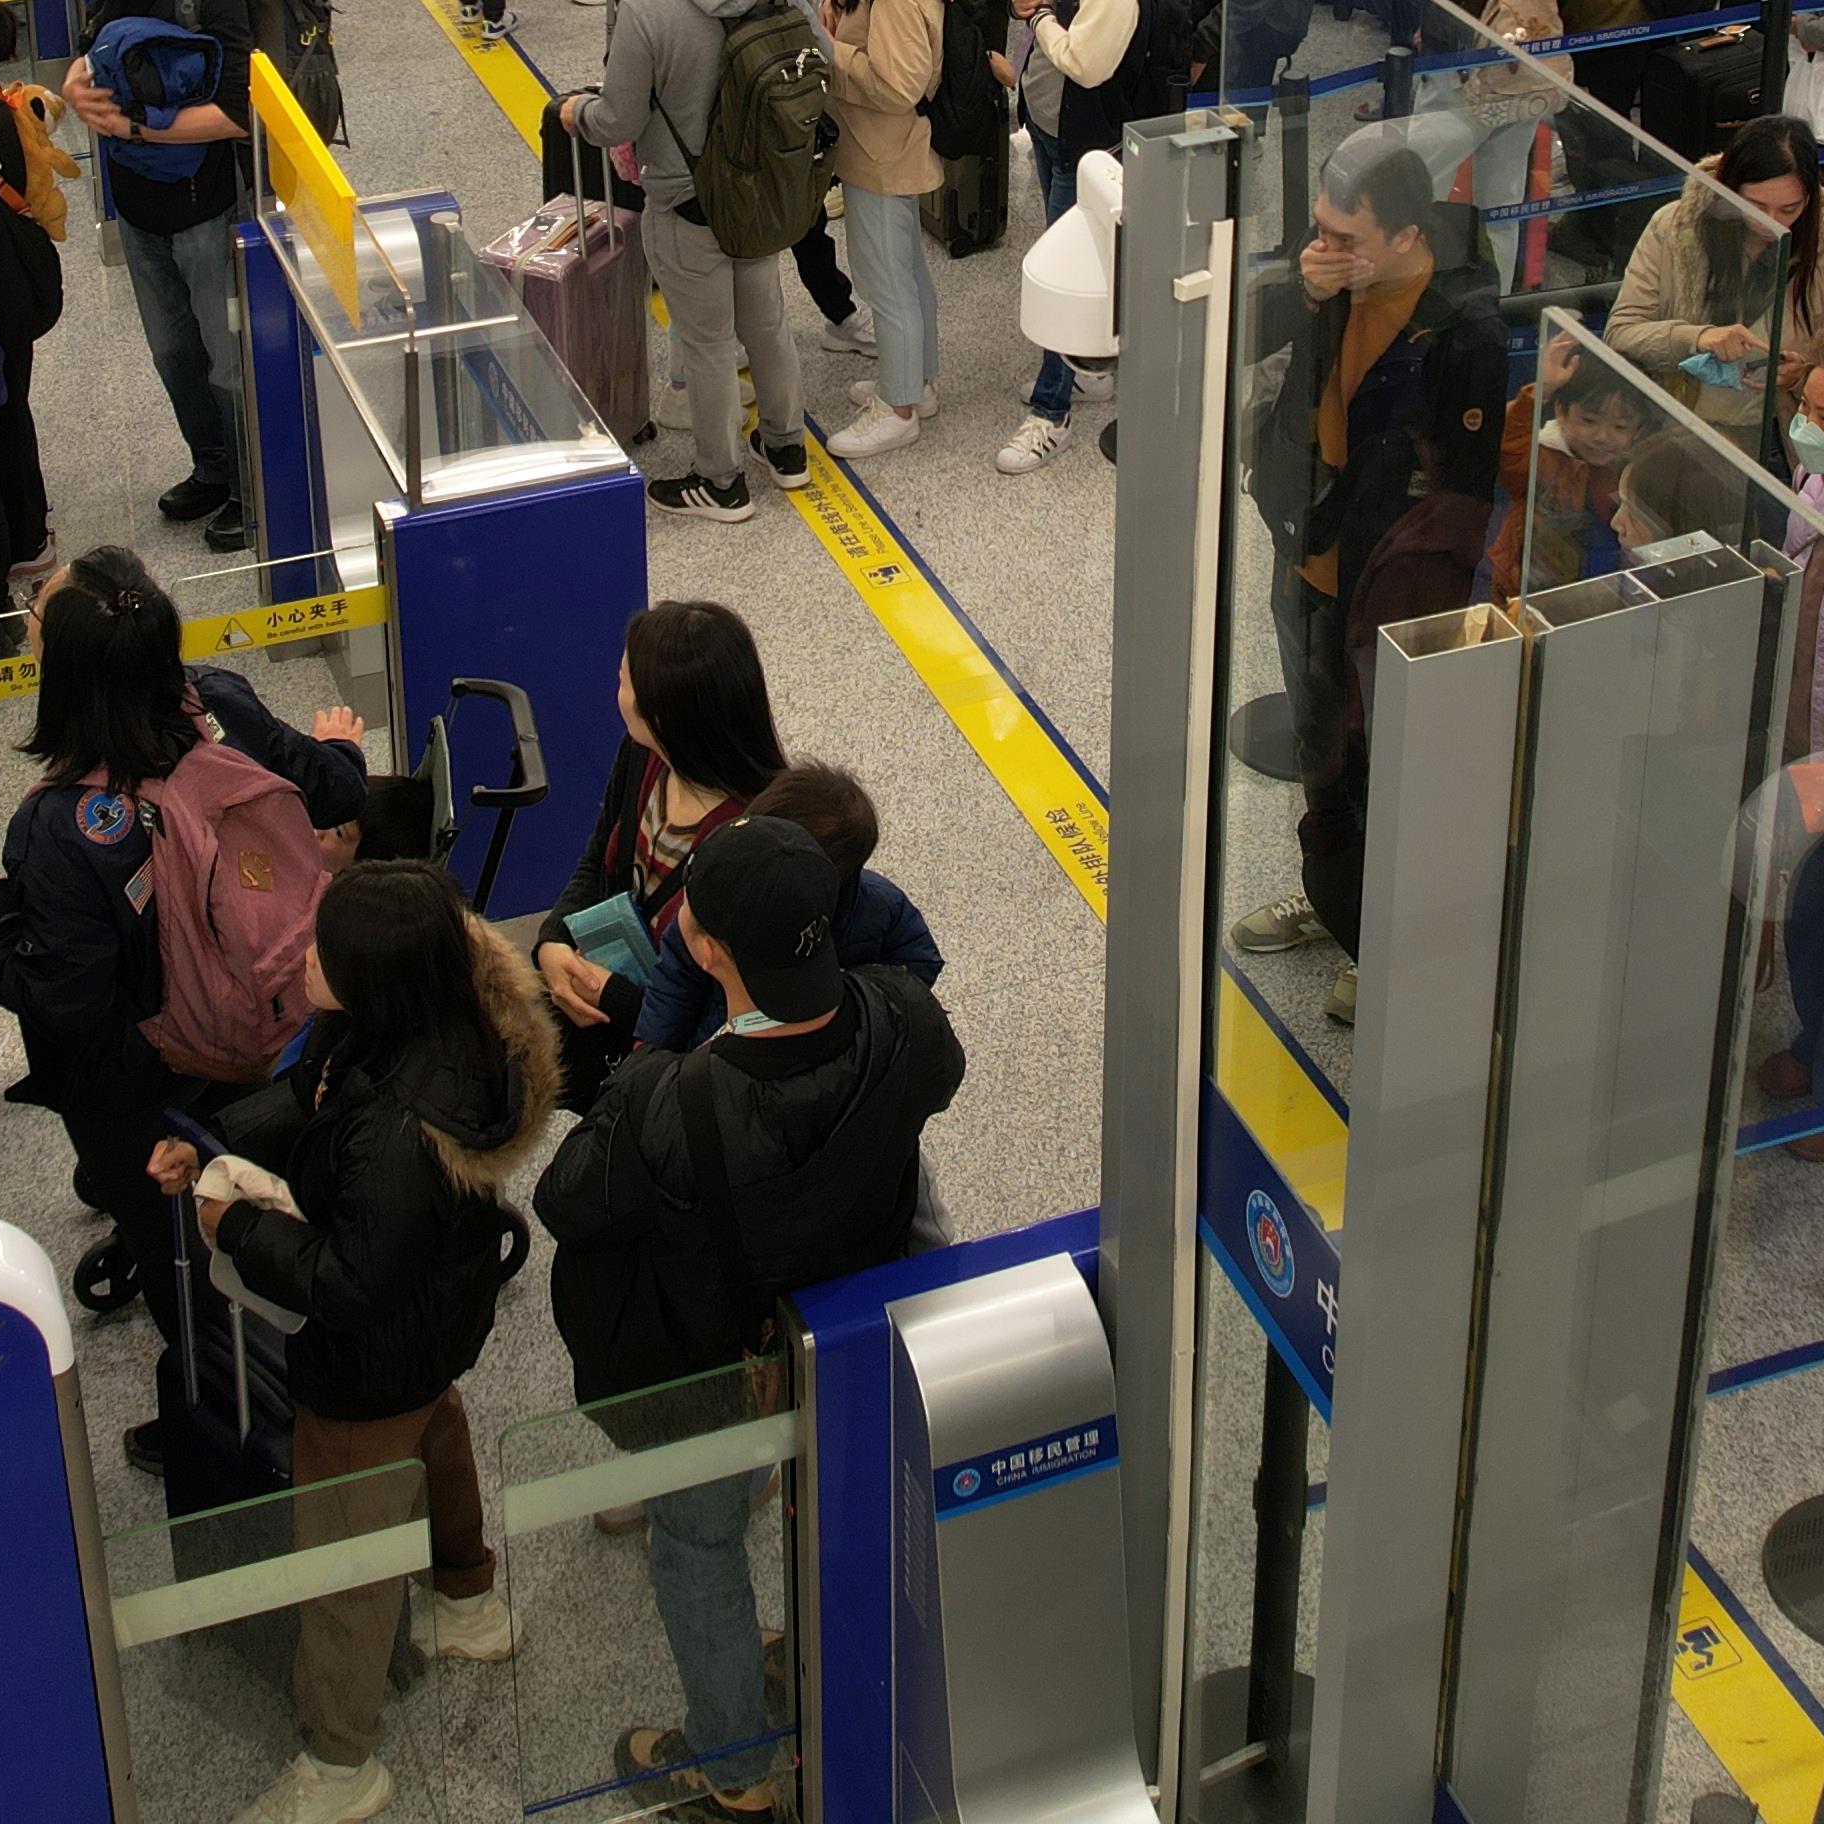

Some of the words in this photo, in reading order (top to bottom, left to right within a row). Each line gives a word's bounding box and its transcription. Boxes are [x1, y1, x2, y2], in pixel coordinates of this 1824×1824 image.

[1568, 34, 1595, 47] CHINA
[1596, 26, 1650, 42] IMMIGRATION
[266, 599, 349, 628] 小心夹手
[1075, 801, 1095, 822] Line
[1317, 1278, 1340, 1336] 中
[990, 1428, 1100, 1476] 中国移民管理
[995, 1471, 1028, 1488] CHINA
[1031, 1447, 1098, 1476] IMMIGRATION
